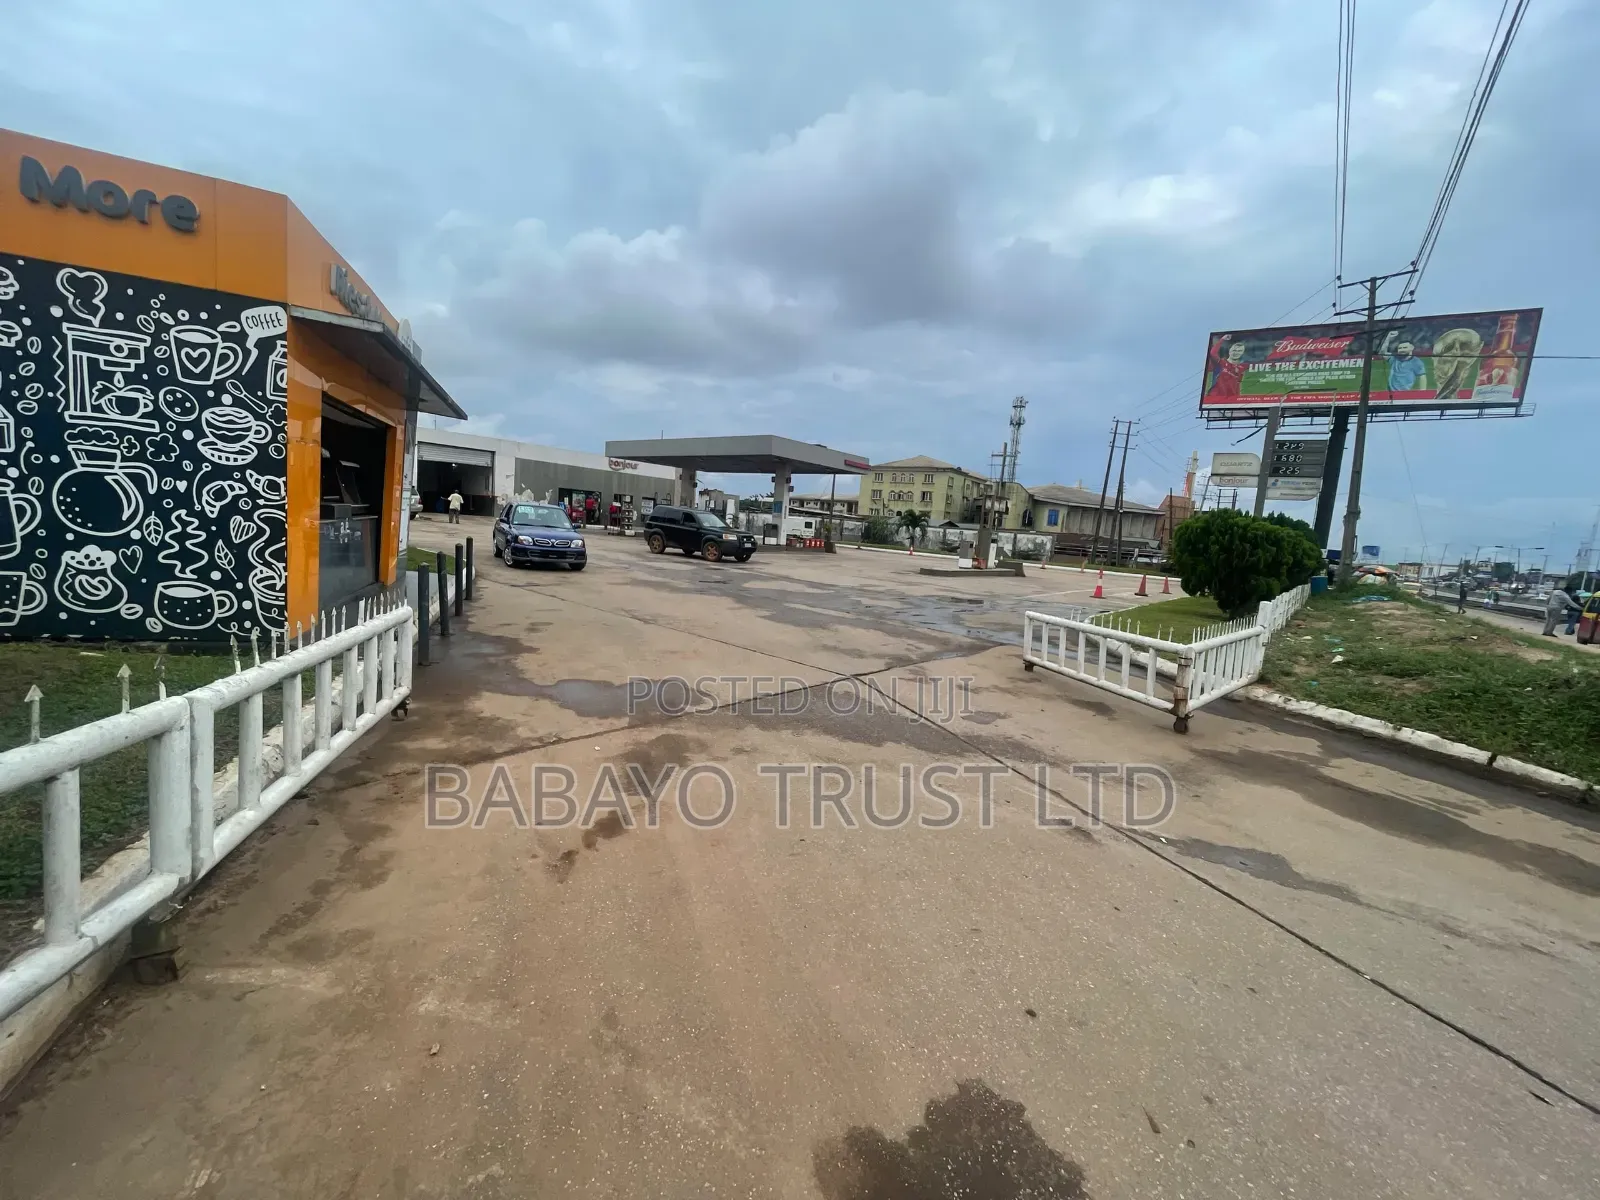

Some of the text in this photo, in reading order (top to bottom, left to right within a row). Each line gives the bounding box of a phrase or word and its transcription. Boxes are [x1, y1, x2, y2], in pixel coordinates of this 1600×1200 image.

[19, 153, 200, 233] More
[245, 312, 284, 330] COFFEE
[1274, 338, 1350, 353] Budweiser
[1248, 358, 1365, 373] LIVE THE EXCITEMEN
[608, 457, 639, 471] bonjour
[1279, 467, 1300, 475] 225
